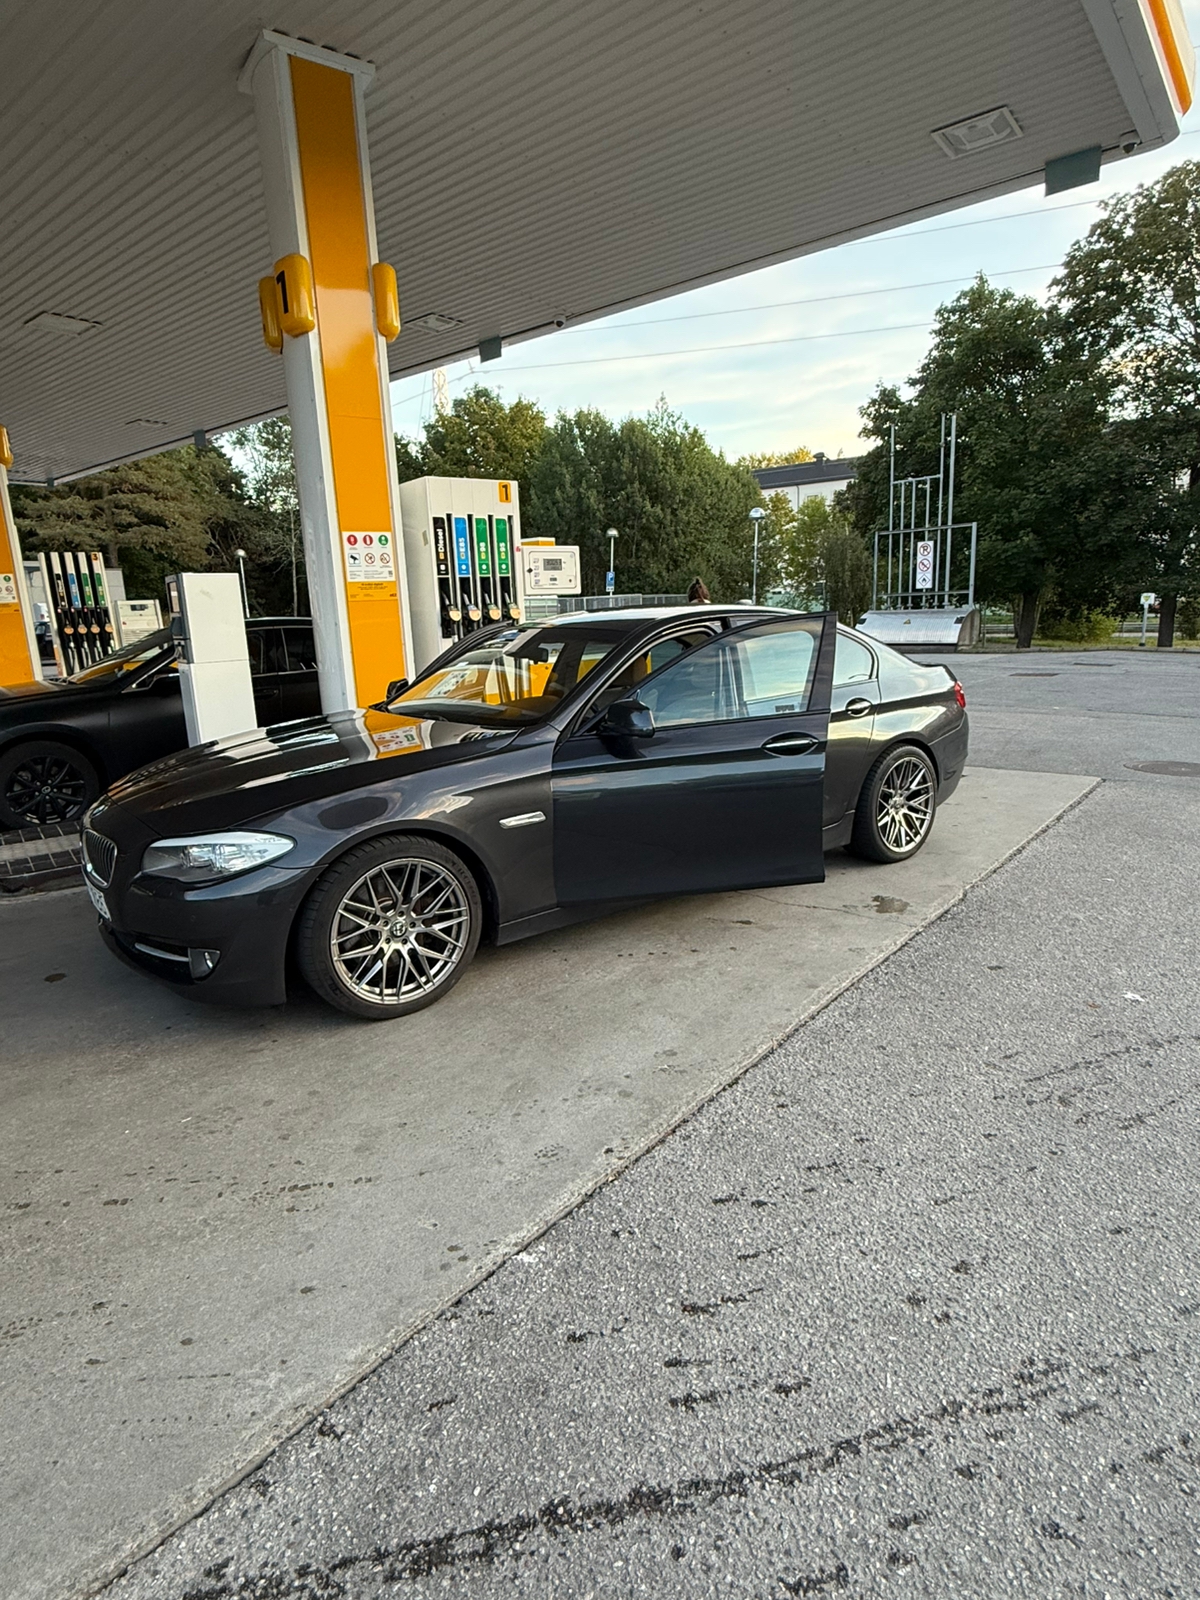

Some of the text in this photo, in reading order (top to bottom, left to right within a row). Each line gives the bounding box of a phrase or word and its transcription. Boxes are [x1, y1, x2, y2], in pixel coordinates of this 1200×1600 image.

[276, 270, 289, 314] 1
[502, 484, 508, 501] 1
[436, 528, 445, 552] Diesel
